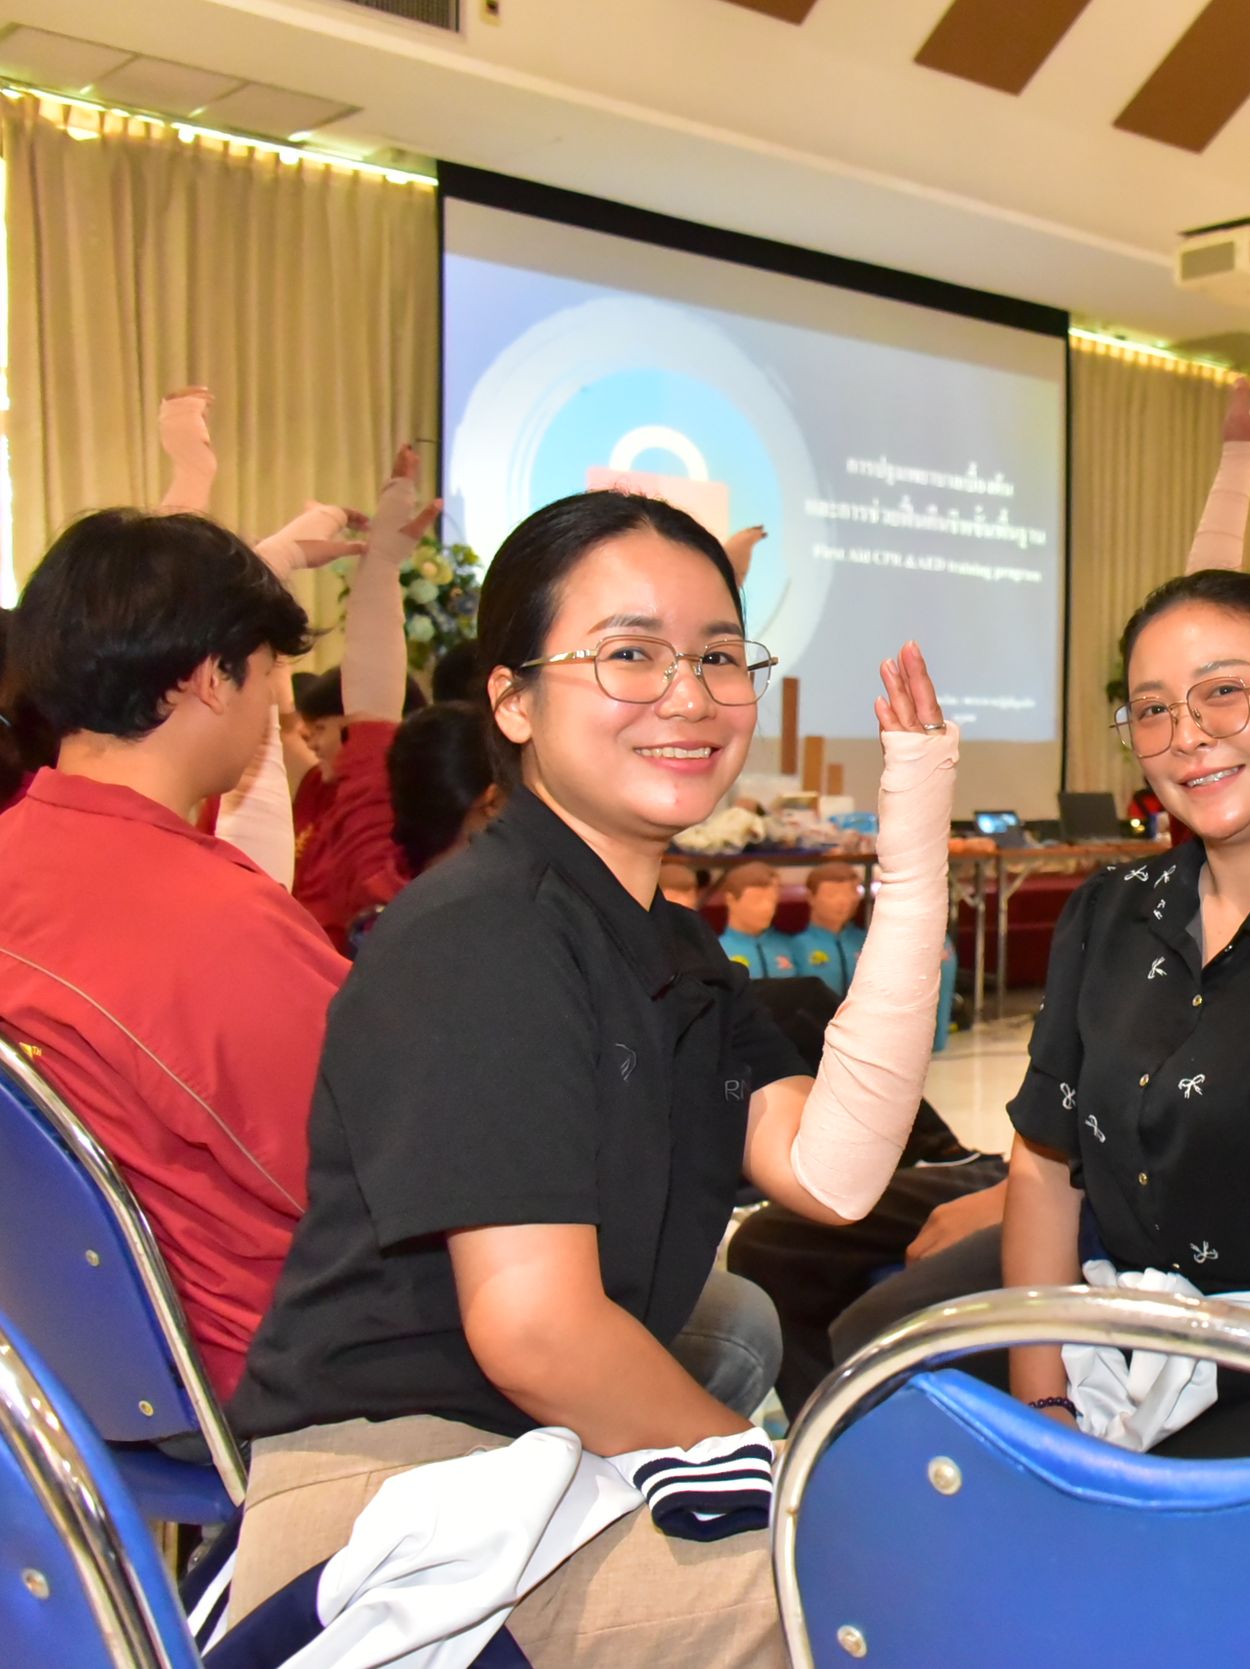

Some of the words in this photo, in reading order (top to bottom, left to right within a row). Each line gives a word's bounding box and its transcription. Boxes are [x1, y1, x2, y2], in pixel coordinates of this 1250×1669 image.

[848, 547, 871, 564] Aid
[872, 550, 902, 566] CPR
[904, 554, 917, 569] &
[918, 556, 946, 572] AED
[947, 560, 992, 581] training
[993, 566, 1042, 583] program
